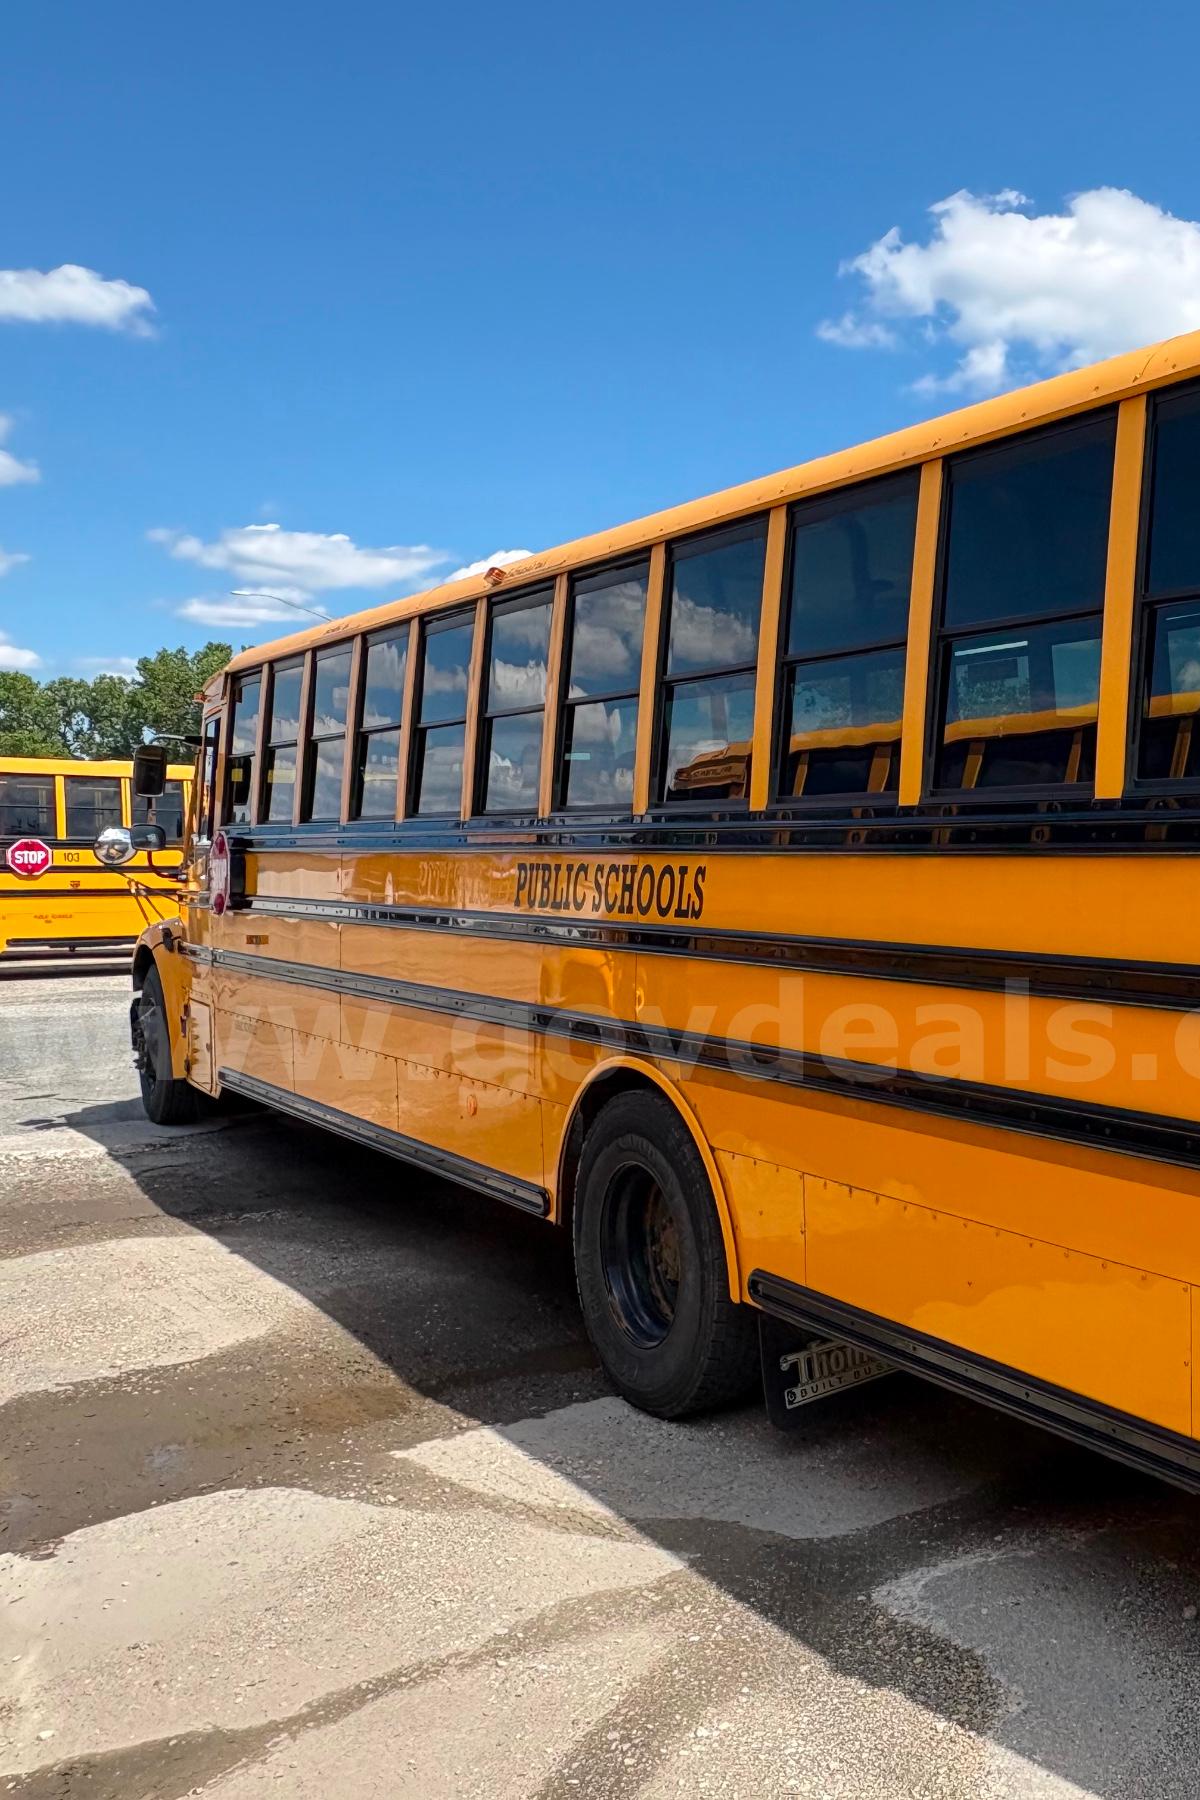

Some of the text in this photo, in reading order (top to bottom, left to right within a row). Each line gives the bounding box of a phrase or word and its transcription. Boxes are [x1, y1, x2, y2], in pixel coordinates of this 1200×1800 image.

[14, 850, 46, 864] STOP
[64, 852, 80, 862] 103
[514, 862, 588, 912] PUBLIC
[592, 863, 706, 920] SCHOOLS
